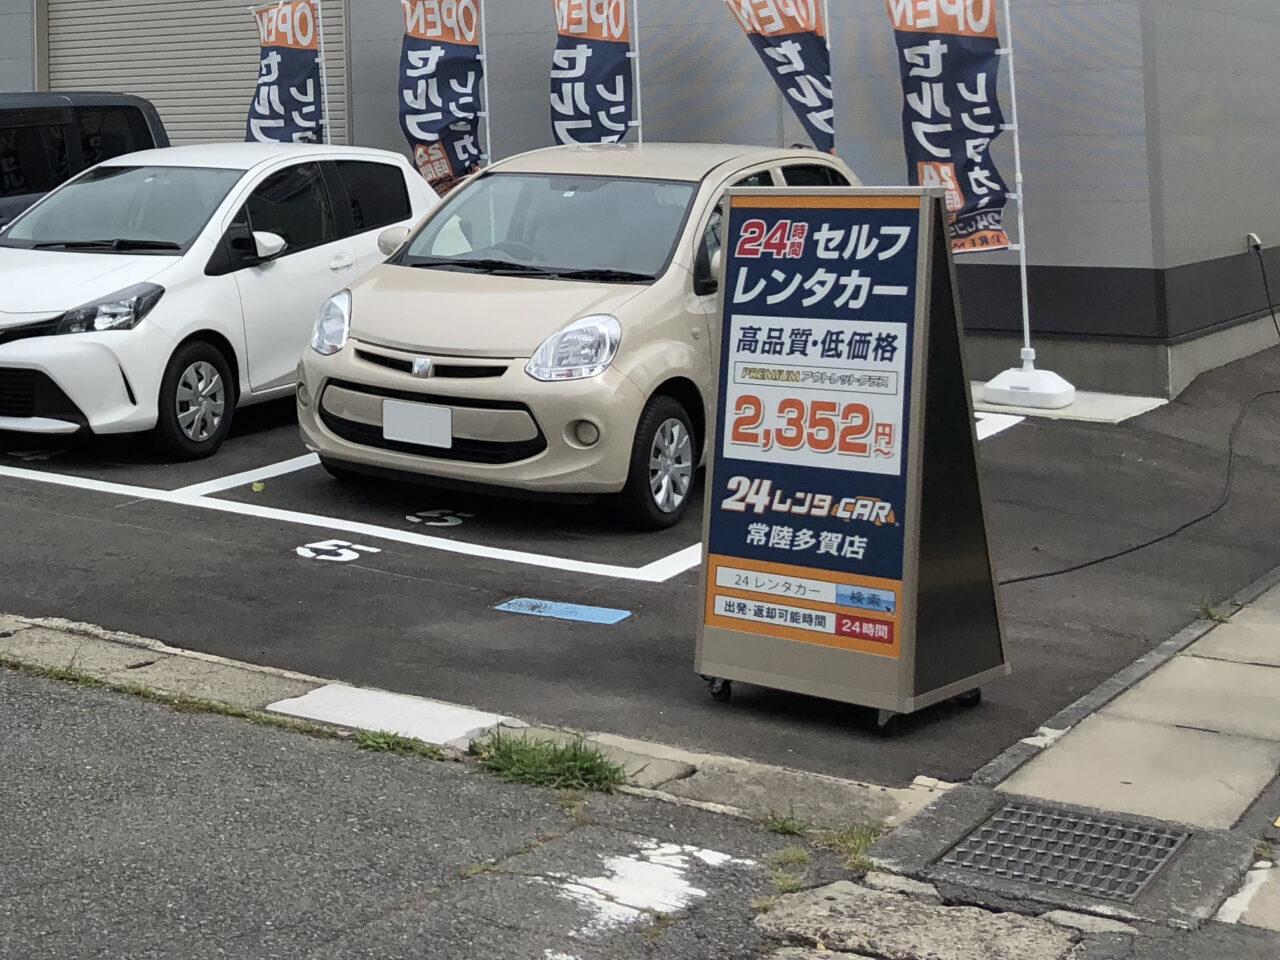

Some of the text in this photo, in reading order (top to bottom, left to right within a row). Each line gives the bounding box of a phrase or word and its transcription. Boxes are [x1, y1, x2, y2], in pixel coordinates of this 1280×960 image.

[812, 223, 911, 261] セルフ
[732, 266, 909, 309] レンタカー
[736, 325, 899, 363] 高品質・低価格
[295, 539, 381, 562] 5
[746, 522, 868, 560] 常陸多賀店
[848, 591, 881, 607] 検索
[841, 619, 889, 639] 24時間
